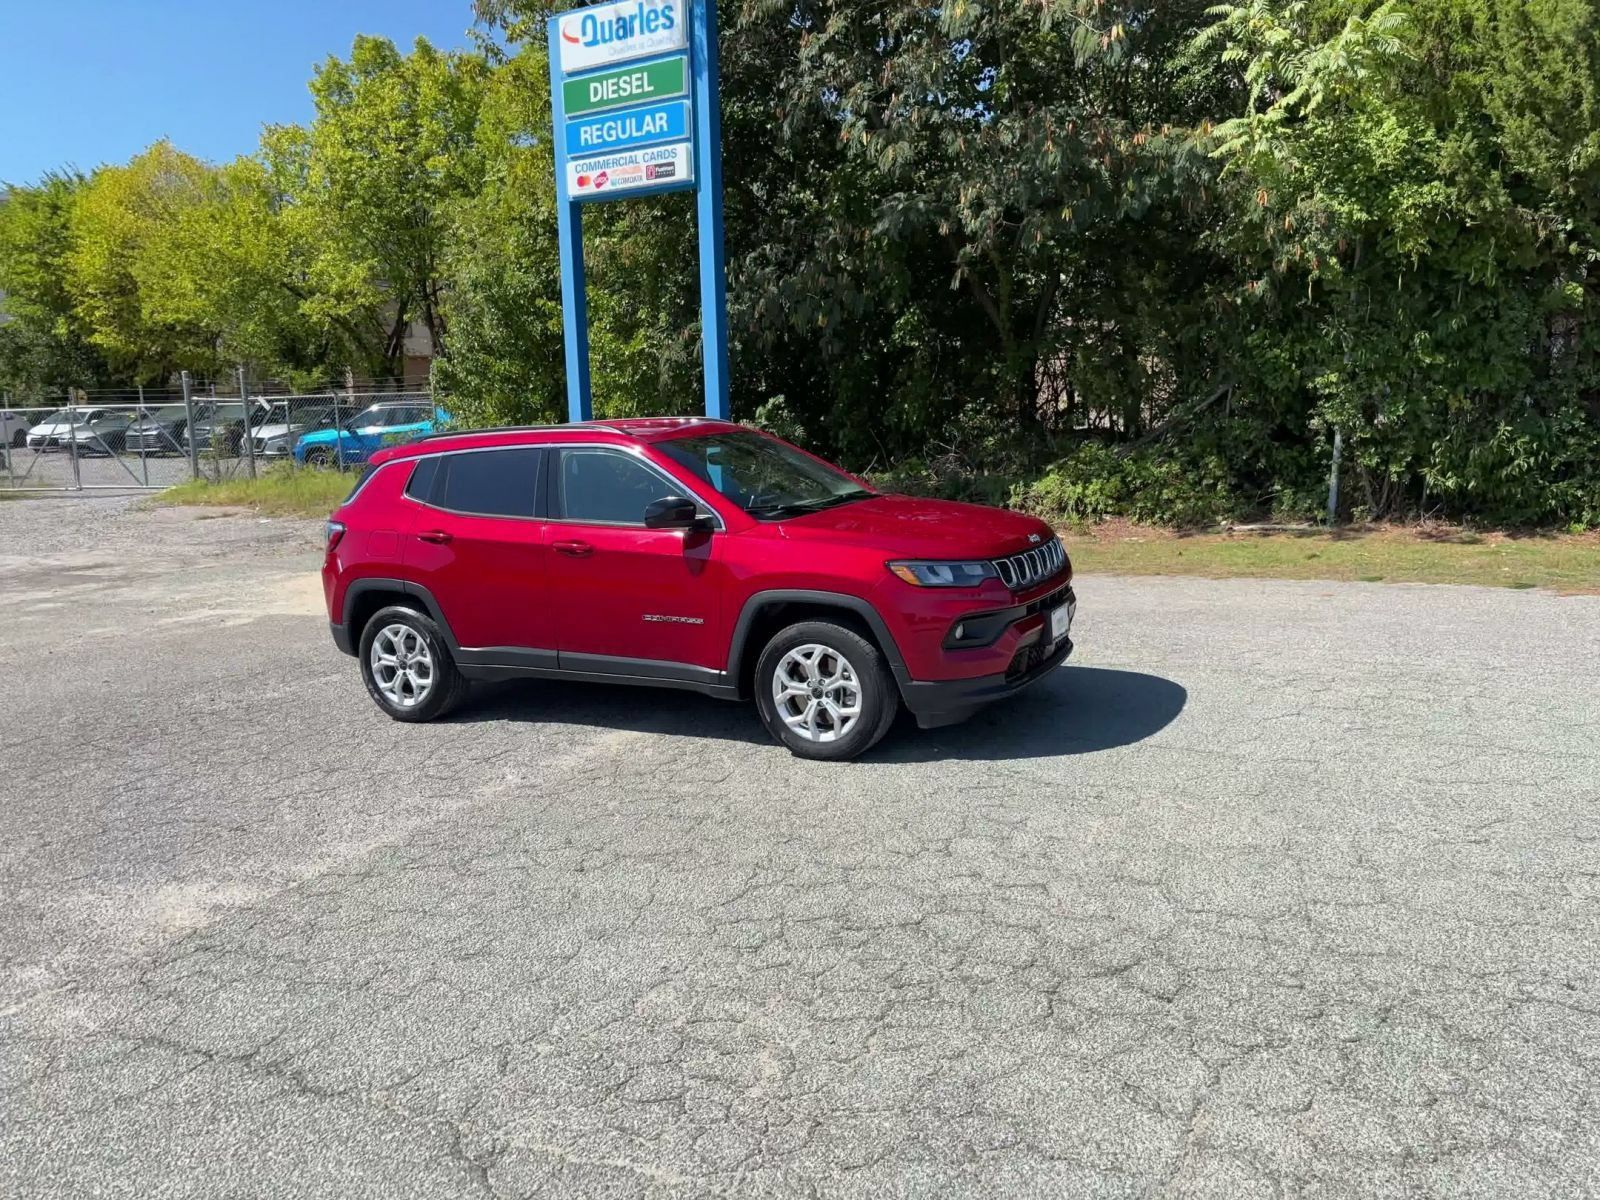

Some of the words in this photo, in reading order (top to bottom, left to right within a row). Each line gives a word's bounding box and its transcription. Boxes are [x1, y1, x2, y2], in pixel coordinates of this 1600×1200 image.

[581, 2, 674, 47] Quarles
[590, 72, 654, 102] DIESEL
[580, 113, 668, 146] REGULAR
[575, 154, 640, 173] COMMERCIAL
[642, 148, 678, 163] CARDS
